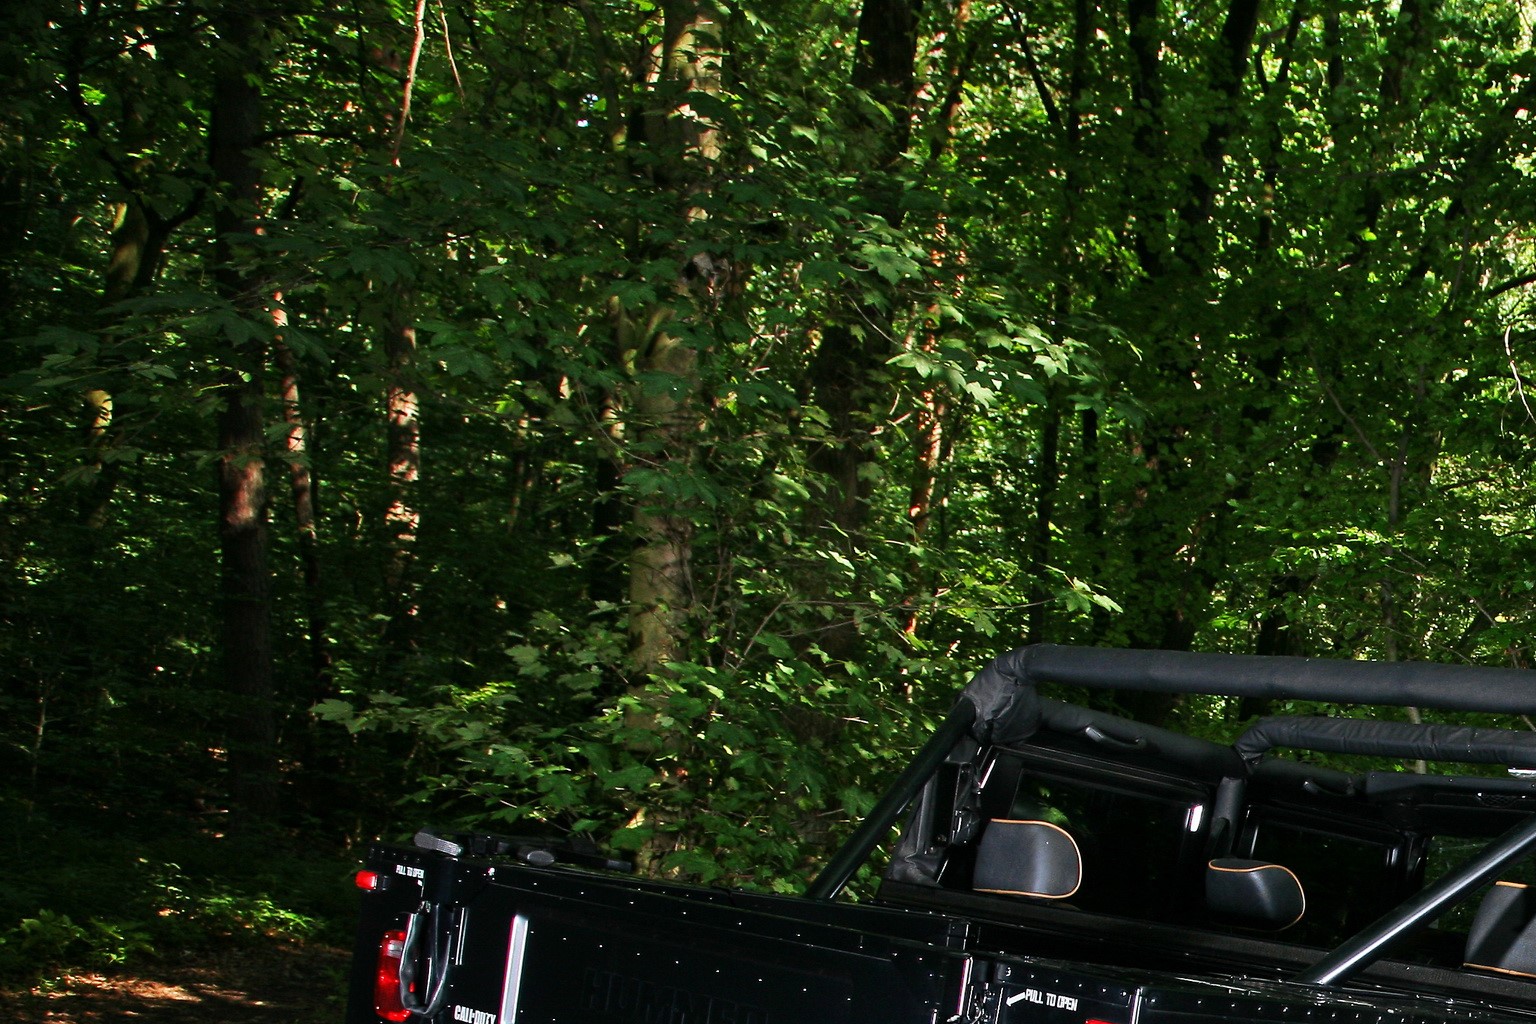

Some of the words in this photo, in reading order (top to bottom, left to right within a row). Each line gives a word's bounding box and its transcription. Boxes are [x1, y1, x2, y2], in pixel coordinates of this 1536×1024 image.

[1025, 988, 1043, 1004] PULL
[1046, 992, 1057, 1007] TO
[1056, 995, 1078, 1012] OPEN
[453, 1004, 473, 1024] CALL
